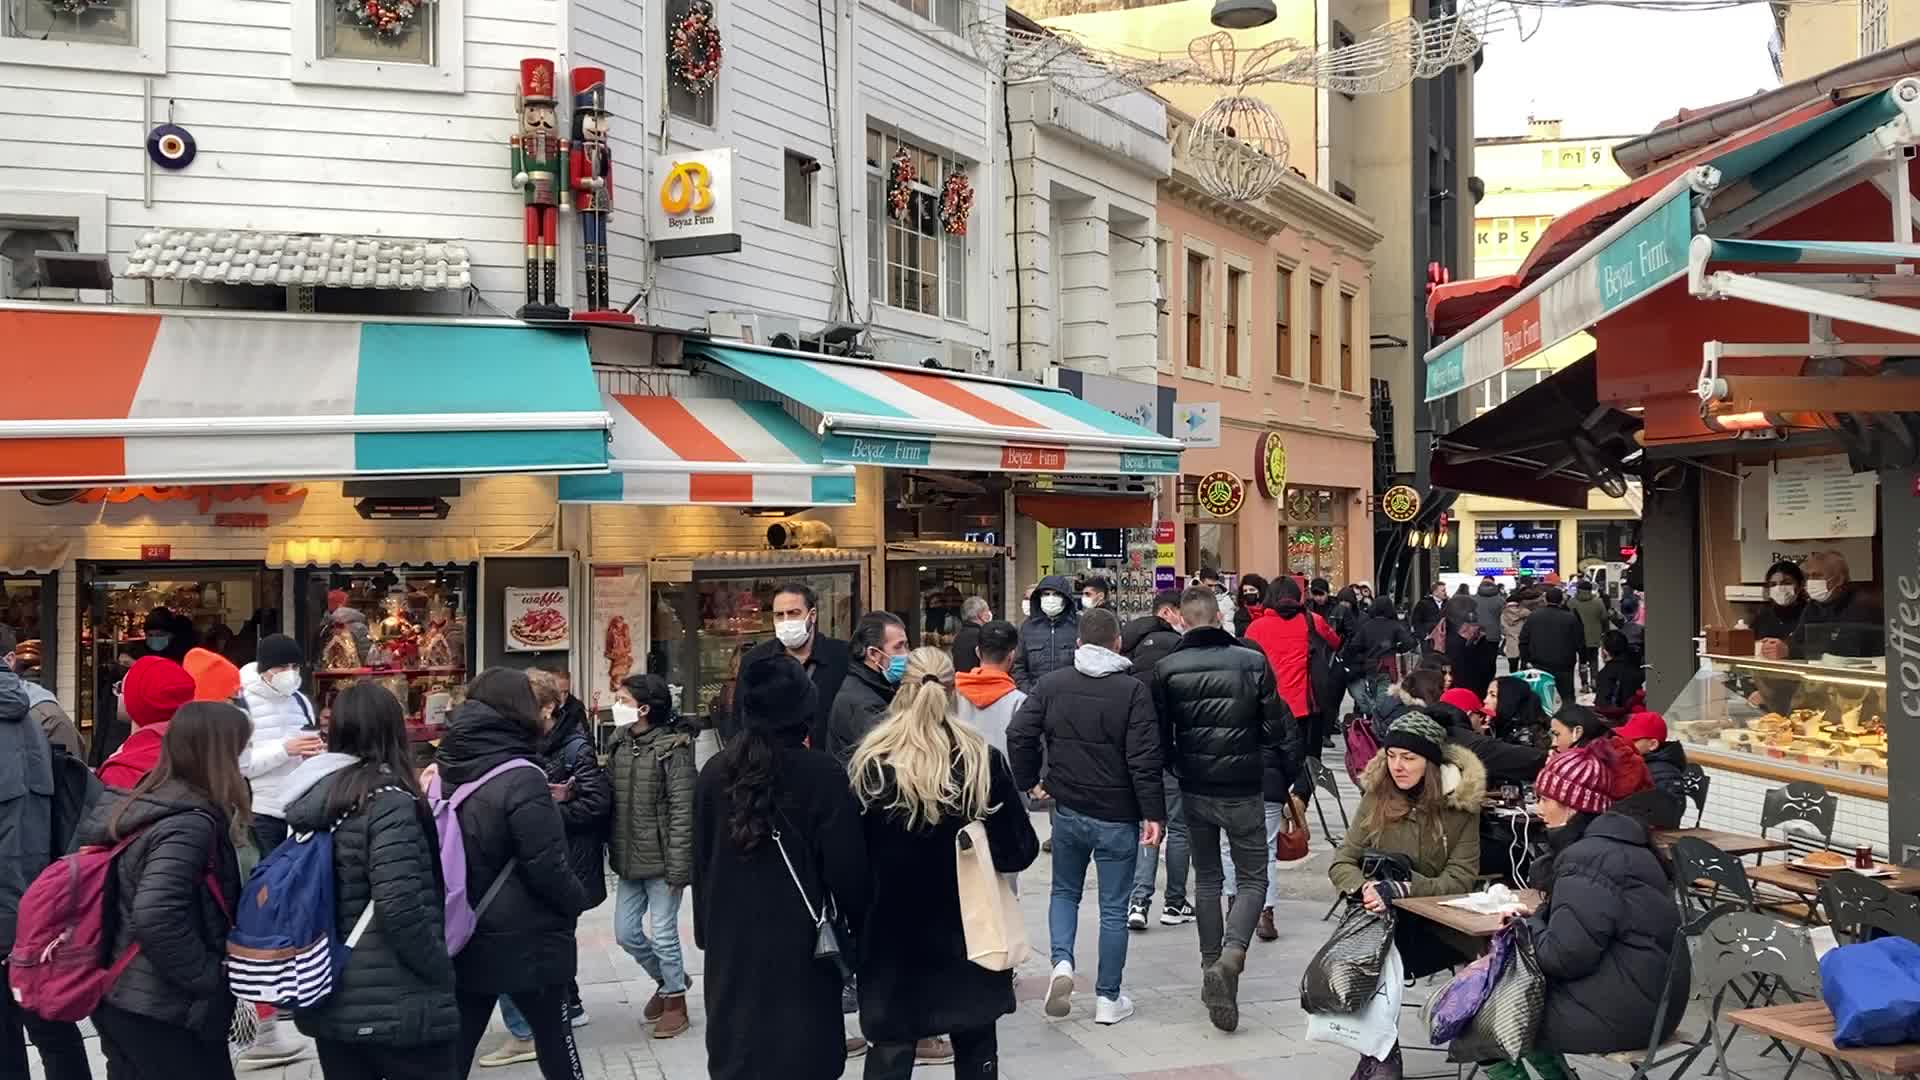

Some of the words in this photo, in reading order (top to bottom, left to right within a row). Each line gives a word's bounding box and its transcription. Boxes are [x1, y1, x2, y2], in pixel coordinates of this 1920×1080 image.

[668, 218, 692, 229] Beyaz
[1604, 259, 1634, 302] Beyaz
[851, 439, 887, 463] Beyaz
[1007, 447, 1033, 469] Beyaz
[1081, 532, 1102, 549] TL
[521, 591, 565, 607] waffle
[1889, 575, 1920, 717] coffee
